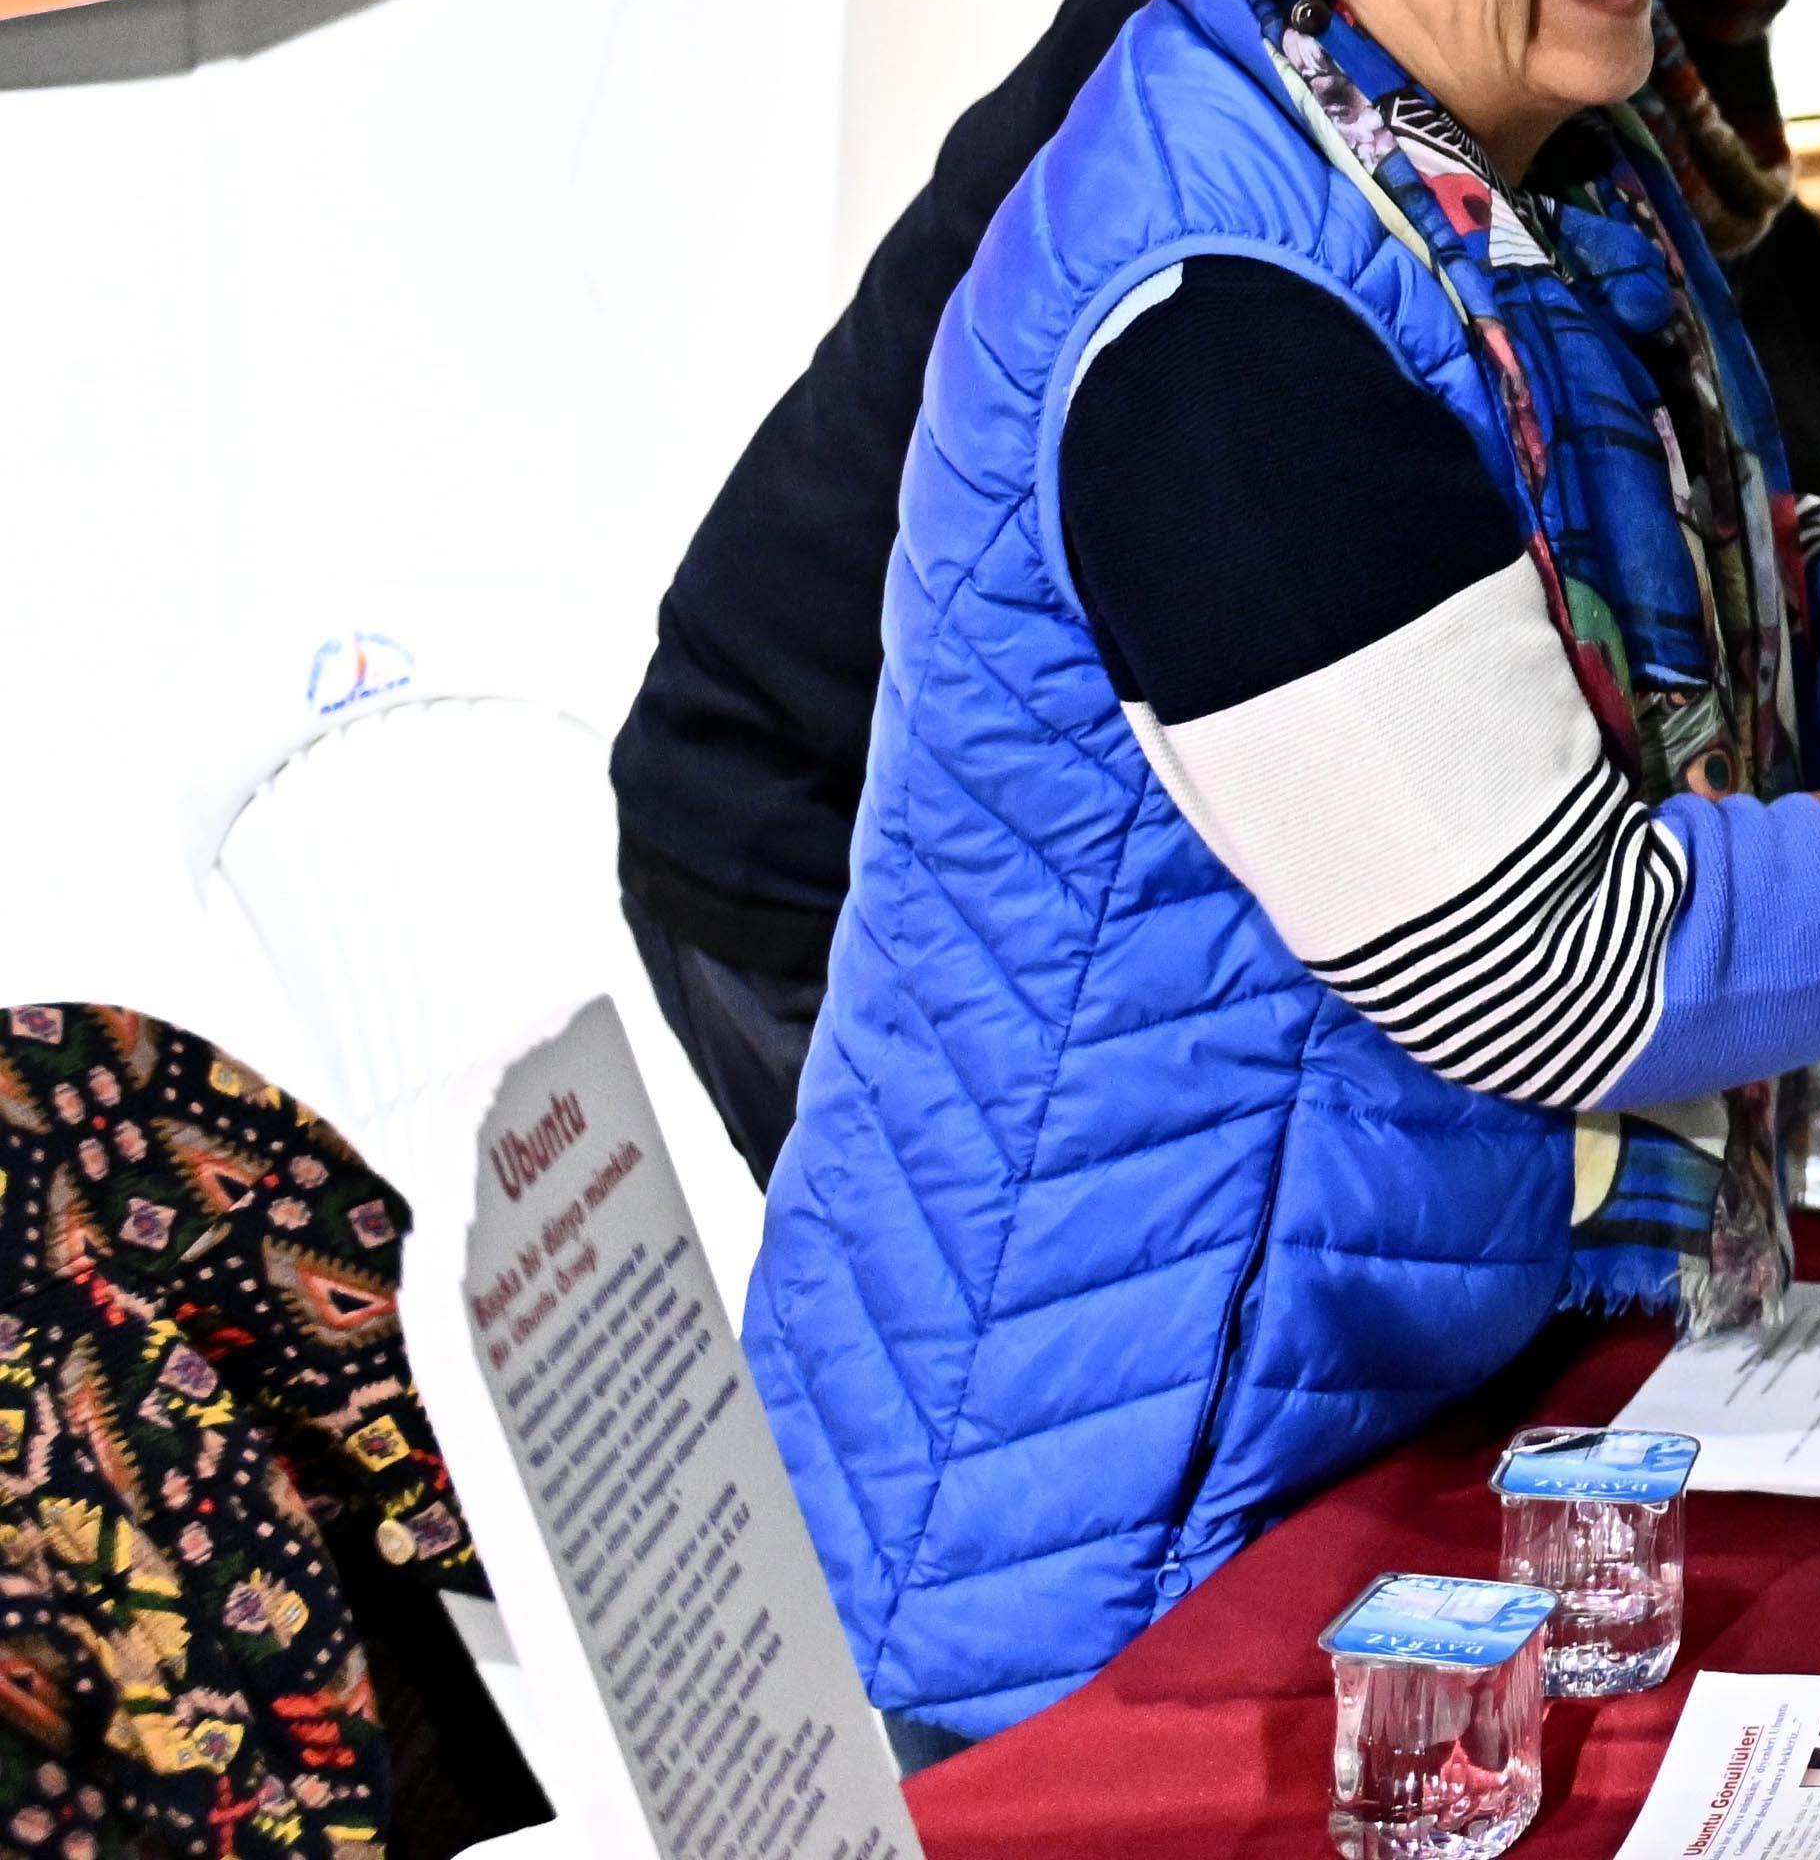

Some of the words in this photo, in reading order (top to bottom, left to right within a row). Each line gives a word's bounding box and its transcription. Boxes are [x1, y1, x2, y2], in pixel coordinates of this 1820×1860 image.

[490, 1093, 586, 1201] Ubuntu
[1533, 1476, 1648, 1494] DAVRAZ
[1366, 1632, 1485, 1655] DAVRAZ
[1682, 1811, 1723, 1857] Ubuntu
[1711, 1725, 1760, 1809] Gönüllüleri
